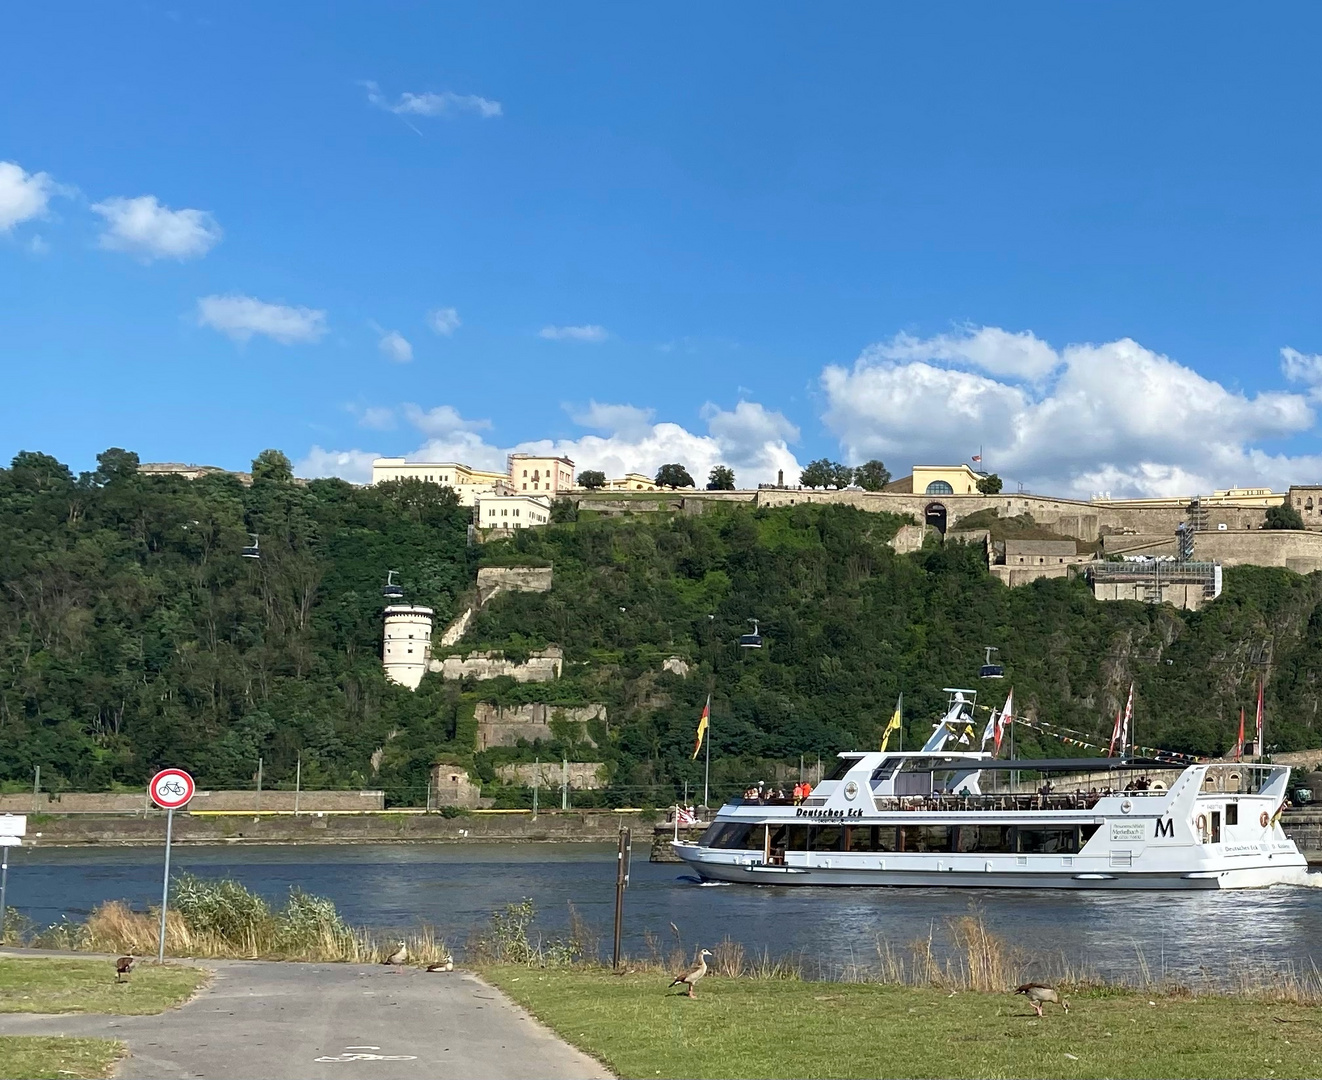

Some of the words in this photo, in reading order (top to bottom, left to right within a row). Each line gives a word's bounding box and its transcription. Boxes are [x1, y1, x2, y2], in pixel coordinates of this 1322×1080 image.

[796, 808, 844, 817] Deutsches
[847, 808, 864, 817] Eck
[1154, 818, 1175, 838] M
